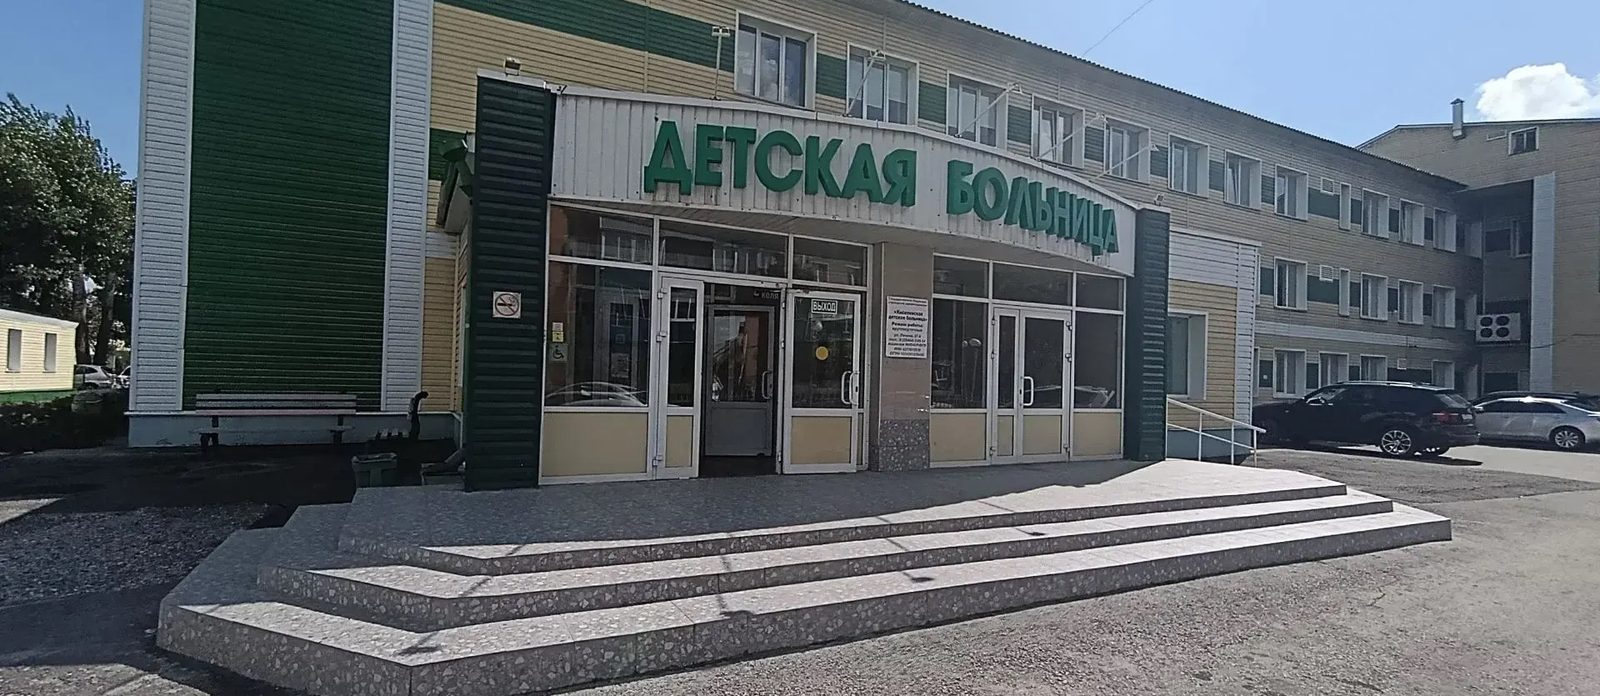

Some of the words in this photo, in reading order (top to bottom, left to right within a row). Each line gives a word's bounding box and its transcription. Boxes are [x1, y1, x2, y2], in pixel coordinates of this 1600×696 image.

[644, 121, 917, 207] ДЕТСКАЯ
[947, 160, 1119, 258] БОЛЬНИЦА
[813, 301, 836, 312] ВЫХОД
